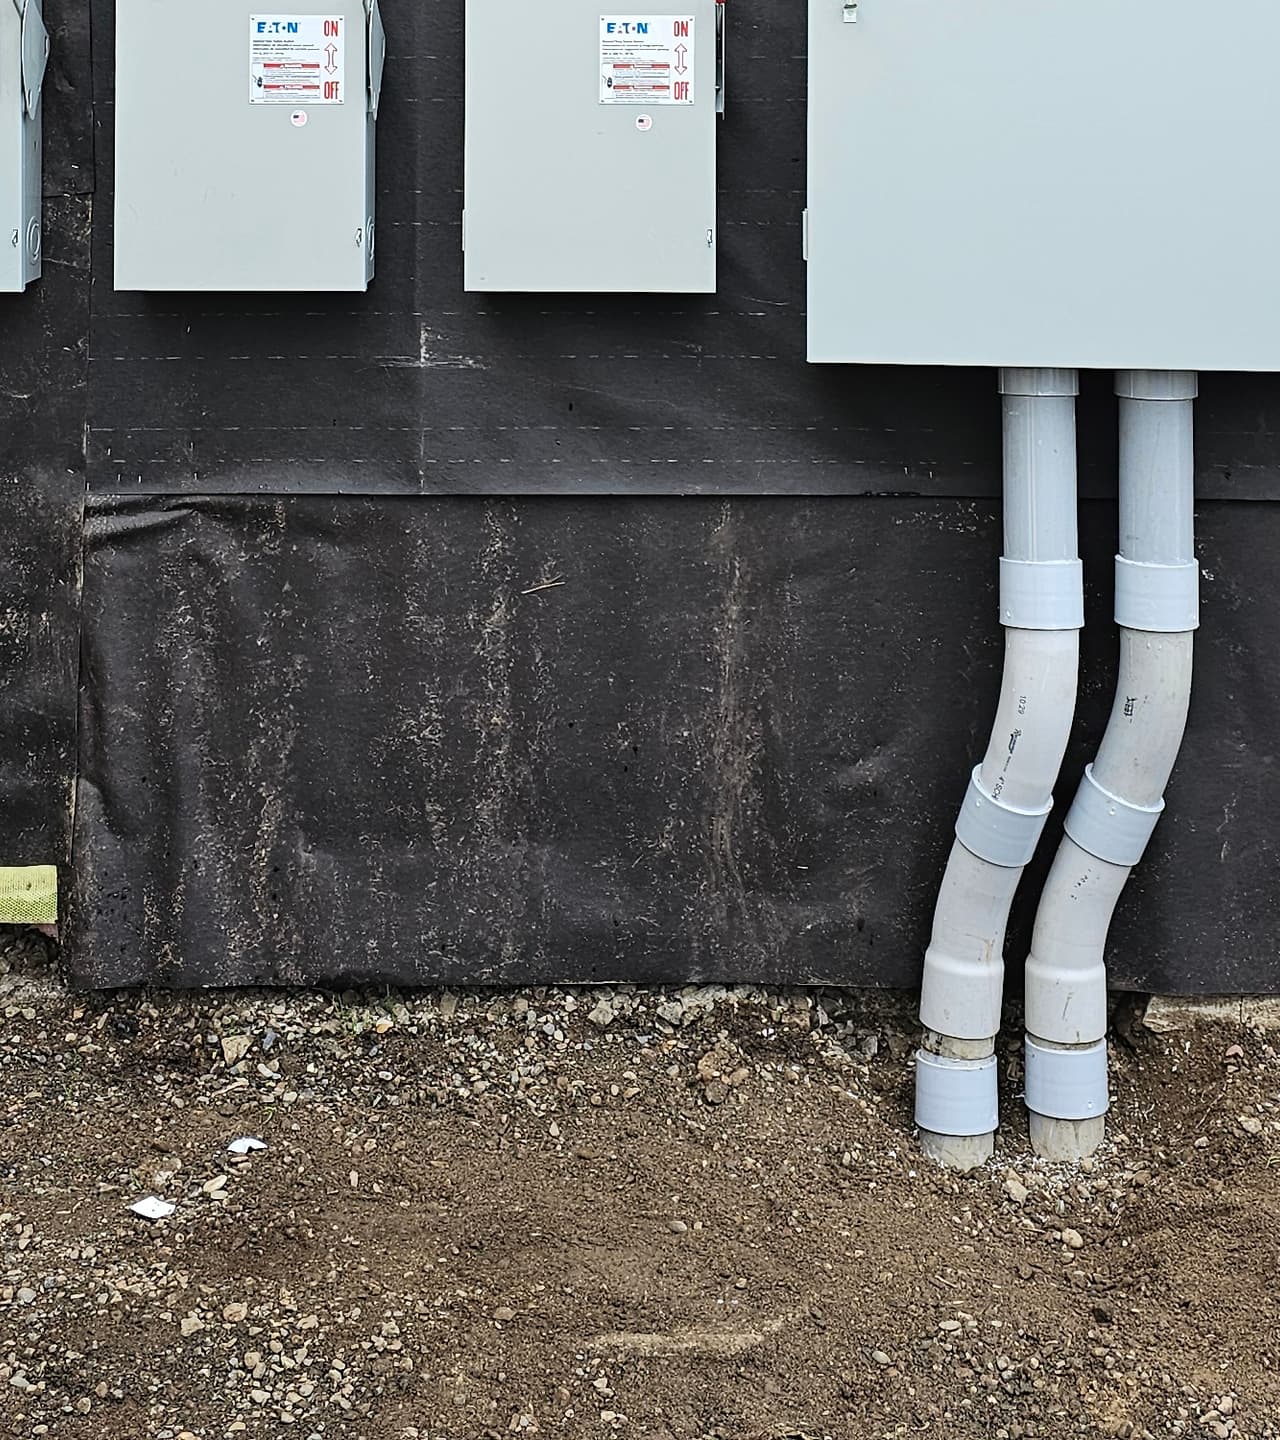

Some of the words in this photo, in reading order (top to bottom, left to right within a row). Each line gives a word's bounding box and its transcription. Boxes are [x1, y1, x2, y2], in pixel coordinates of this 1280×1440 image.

[324, 20, 338, 37] ON
[674, 21, 688, 37] ON
[324, 81, 340, 99] OFF
[674, 81, 689, 100] OFF
